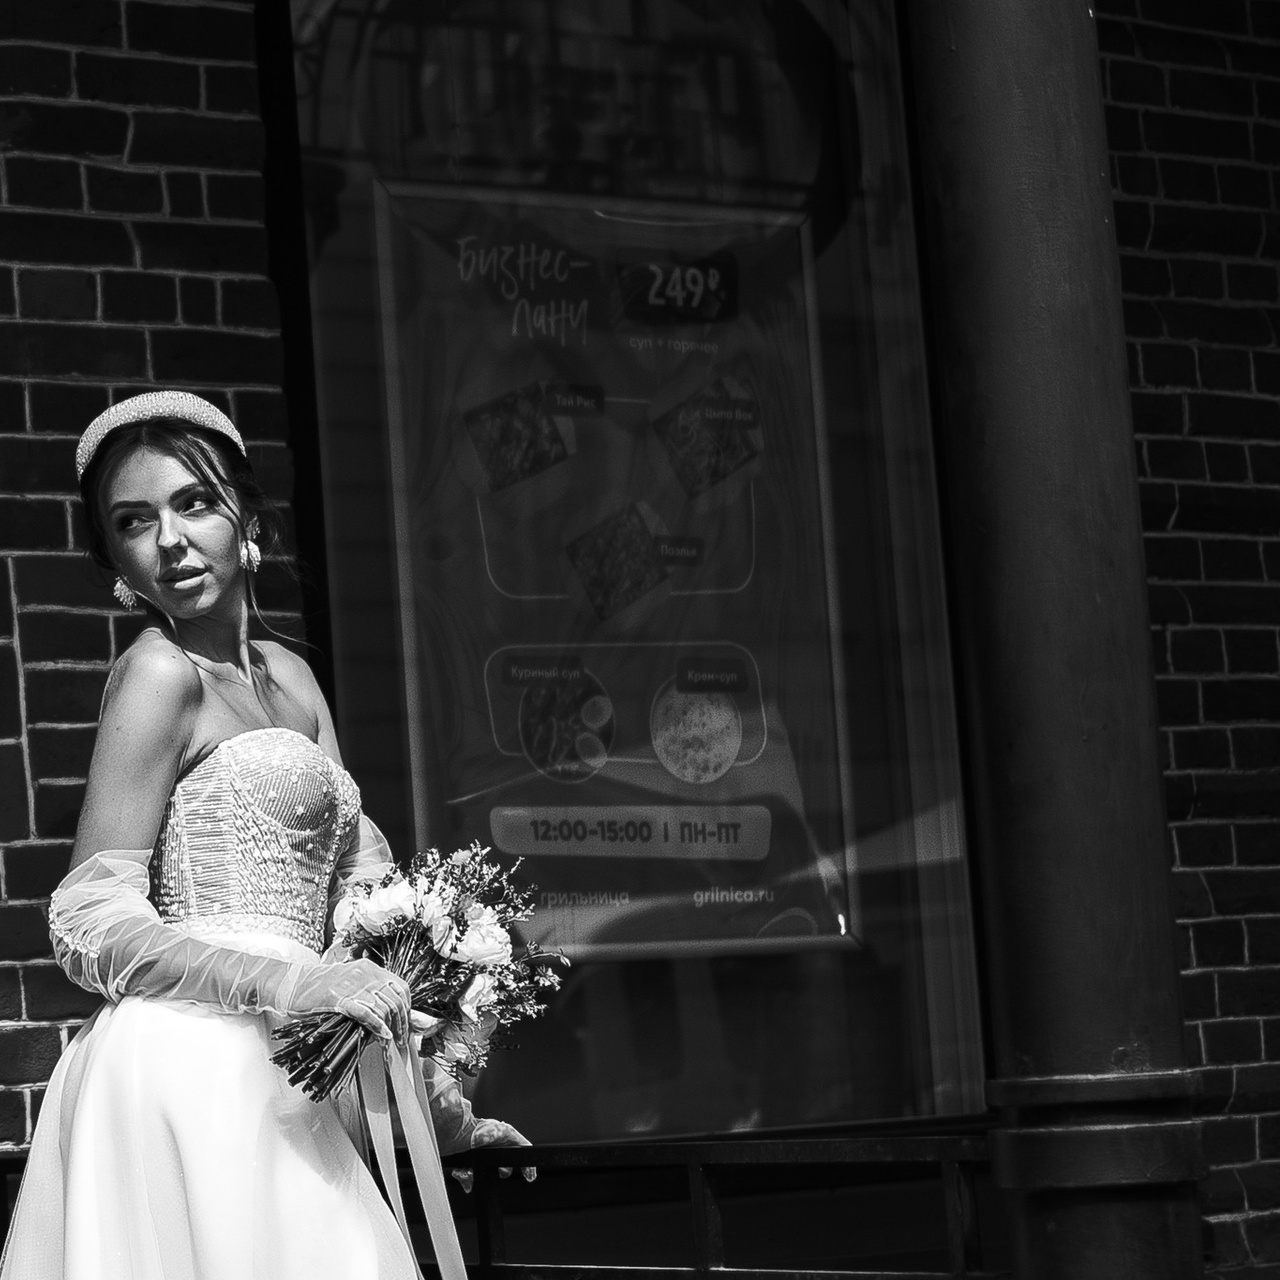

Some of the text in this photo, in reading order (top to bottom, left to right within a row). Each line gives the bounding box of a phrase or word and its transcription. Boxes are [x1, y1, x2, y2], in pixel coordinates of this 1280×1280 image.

[457, 236, 591, 300] Бизнес-
[628, 336, 653, 351] суп
[576, 394, 596, 409] Рис
[510, 665, 581, 683] Куриный суп
[686, 668, 738, 684] Крем-суп
[530, 819, 653, 844] 12:00-15:00
[679, 821, 742, 844] ПН-ПТ
